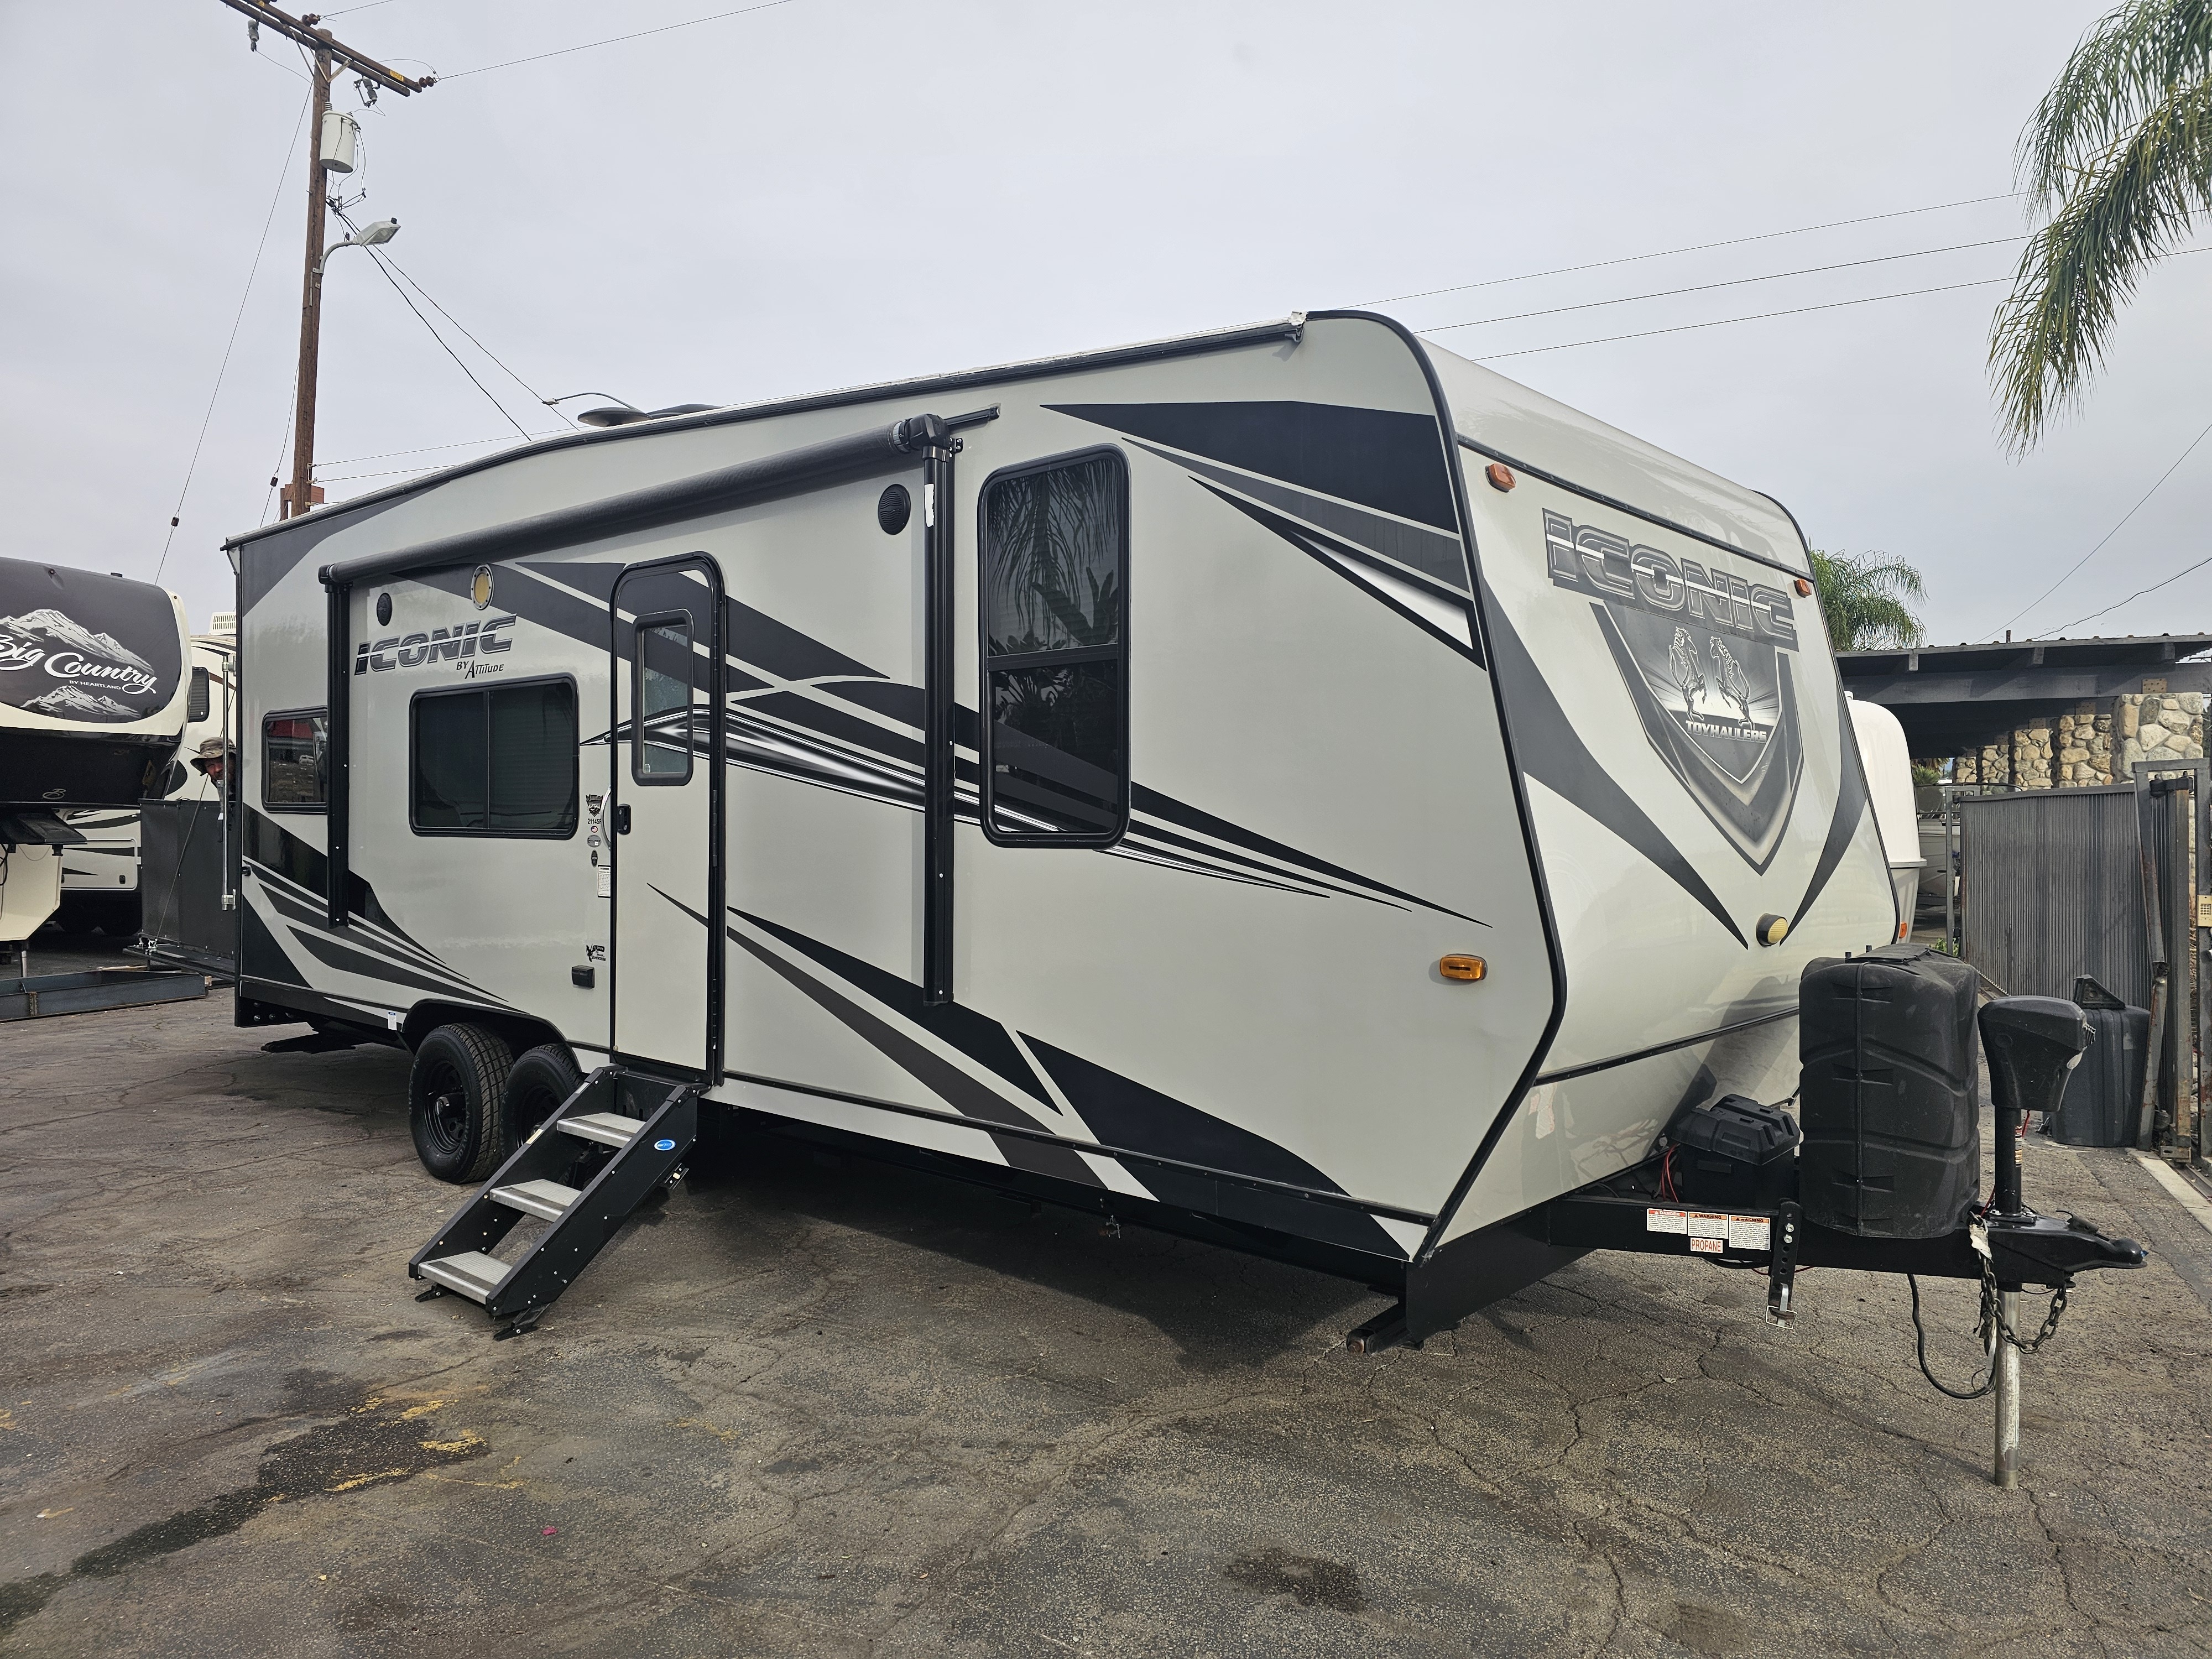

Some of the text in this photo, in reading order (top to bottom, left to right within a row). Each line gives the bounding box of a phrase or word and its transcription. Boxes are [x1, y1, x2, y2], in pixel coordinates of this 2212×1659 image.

[1543, 511, 1794, 641] ICONIC
[354, 613, 517, 676] ICONIC
[44, 652, 158, 695] Country
[456, 661, 469, 670] BY
[80, 681, 121, 690] HEARTLAND
[1686, 719, 1767, 744] TOYHAULERS
[1691, 1239, 1721, 1253] PROPANE
